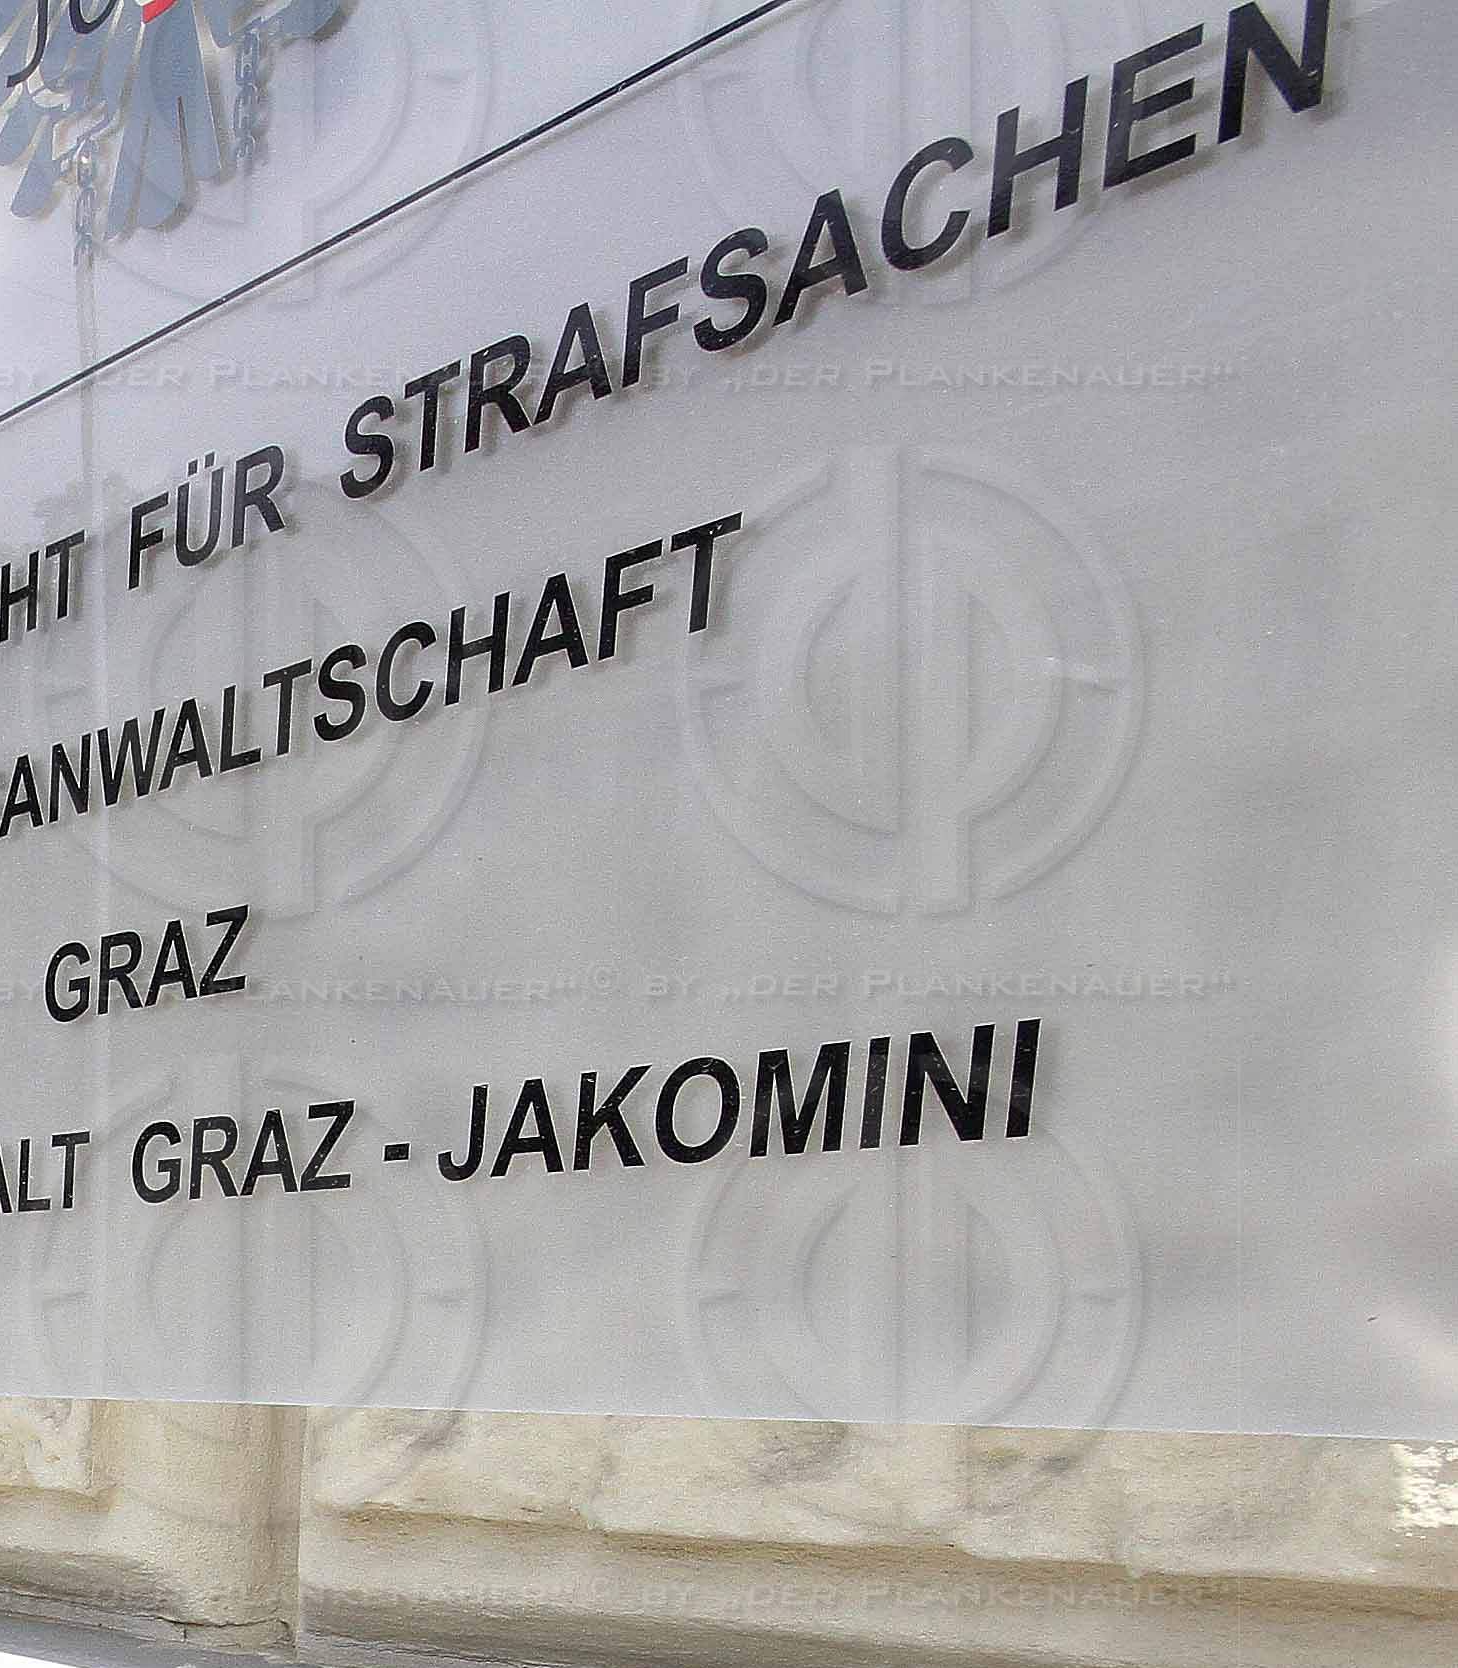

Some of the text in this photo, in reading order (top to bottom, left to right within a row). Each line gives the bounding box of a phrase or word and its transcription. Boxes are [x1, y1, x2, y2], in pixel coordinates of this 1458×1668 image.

[128, 445, 286, 591] FÜR
[339, 0, 1332, 499] STRAFSACHEN
[45, 904, 249, 1023] GRAZ
[131, 1100, 355, 1204] GRAZ
[437, 1018, 1042, 1182] JAKOMINI
